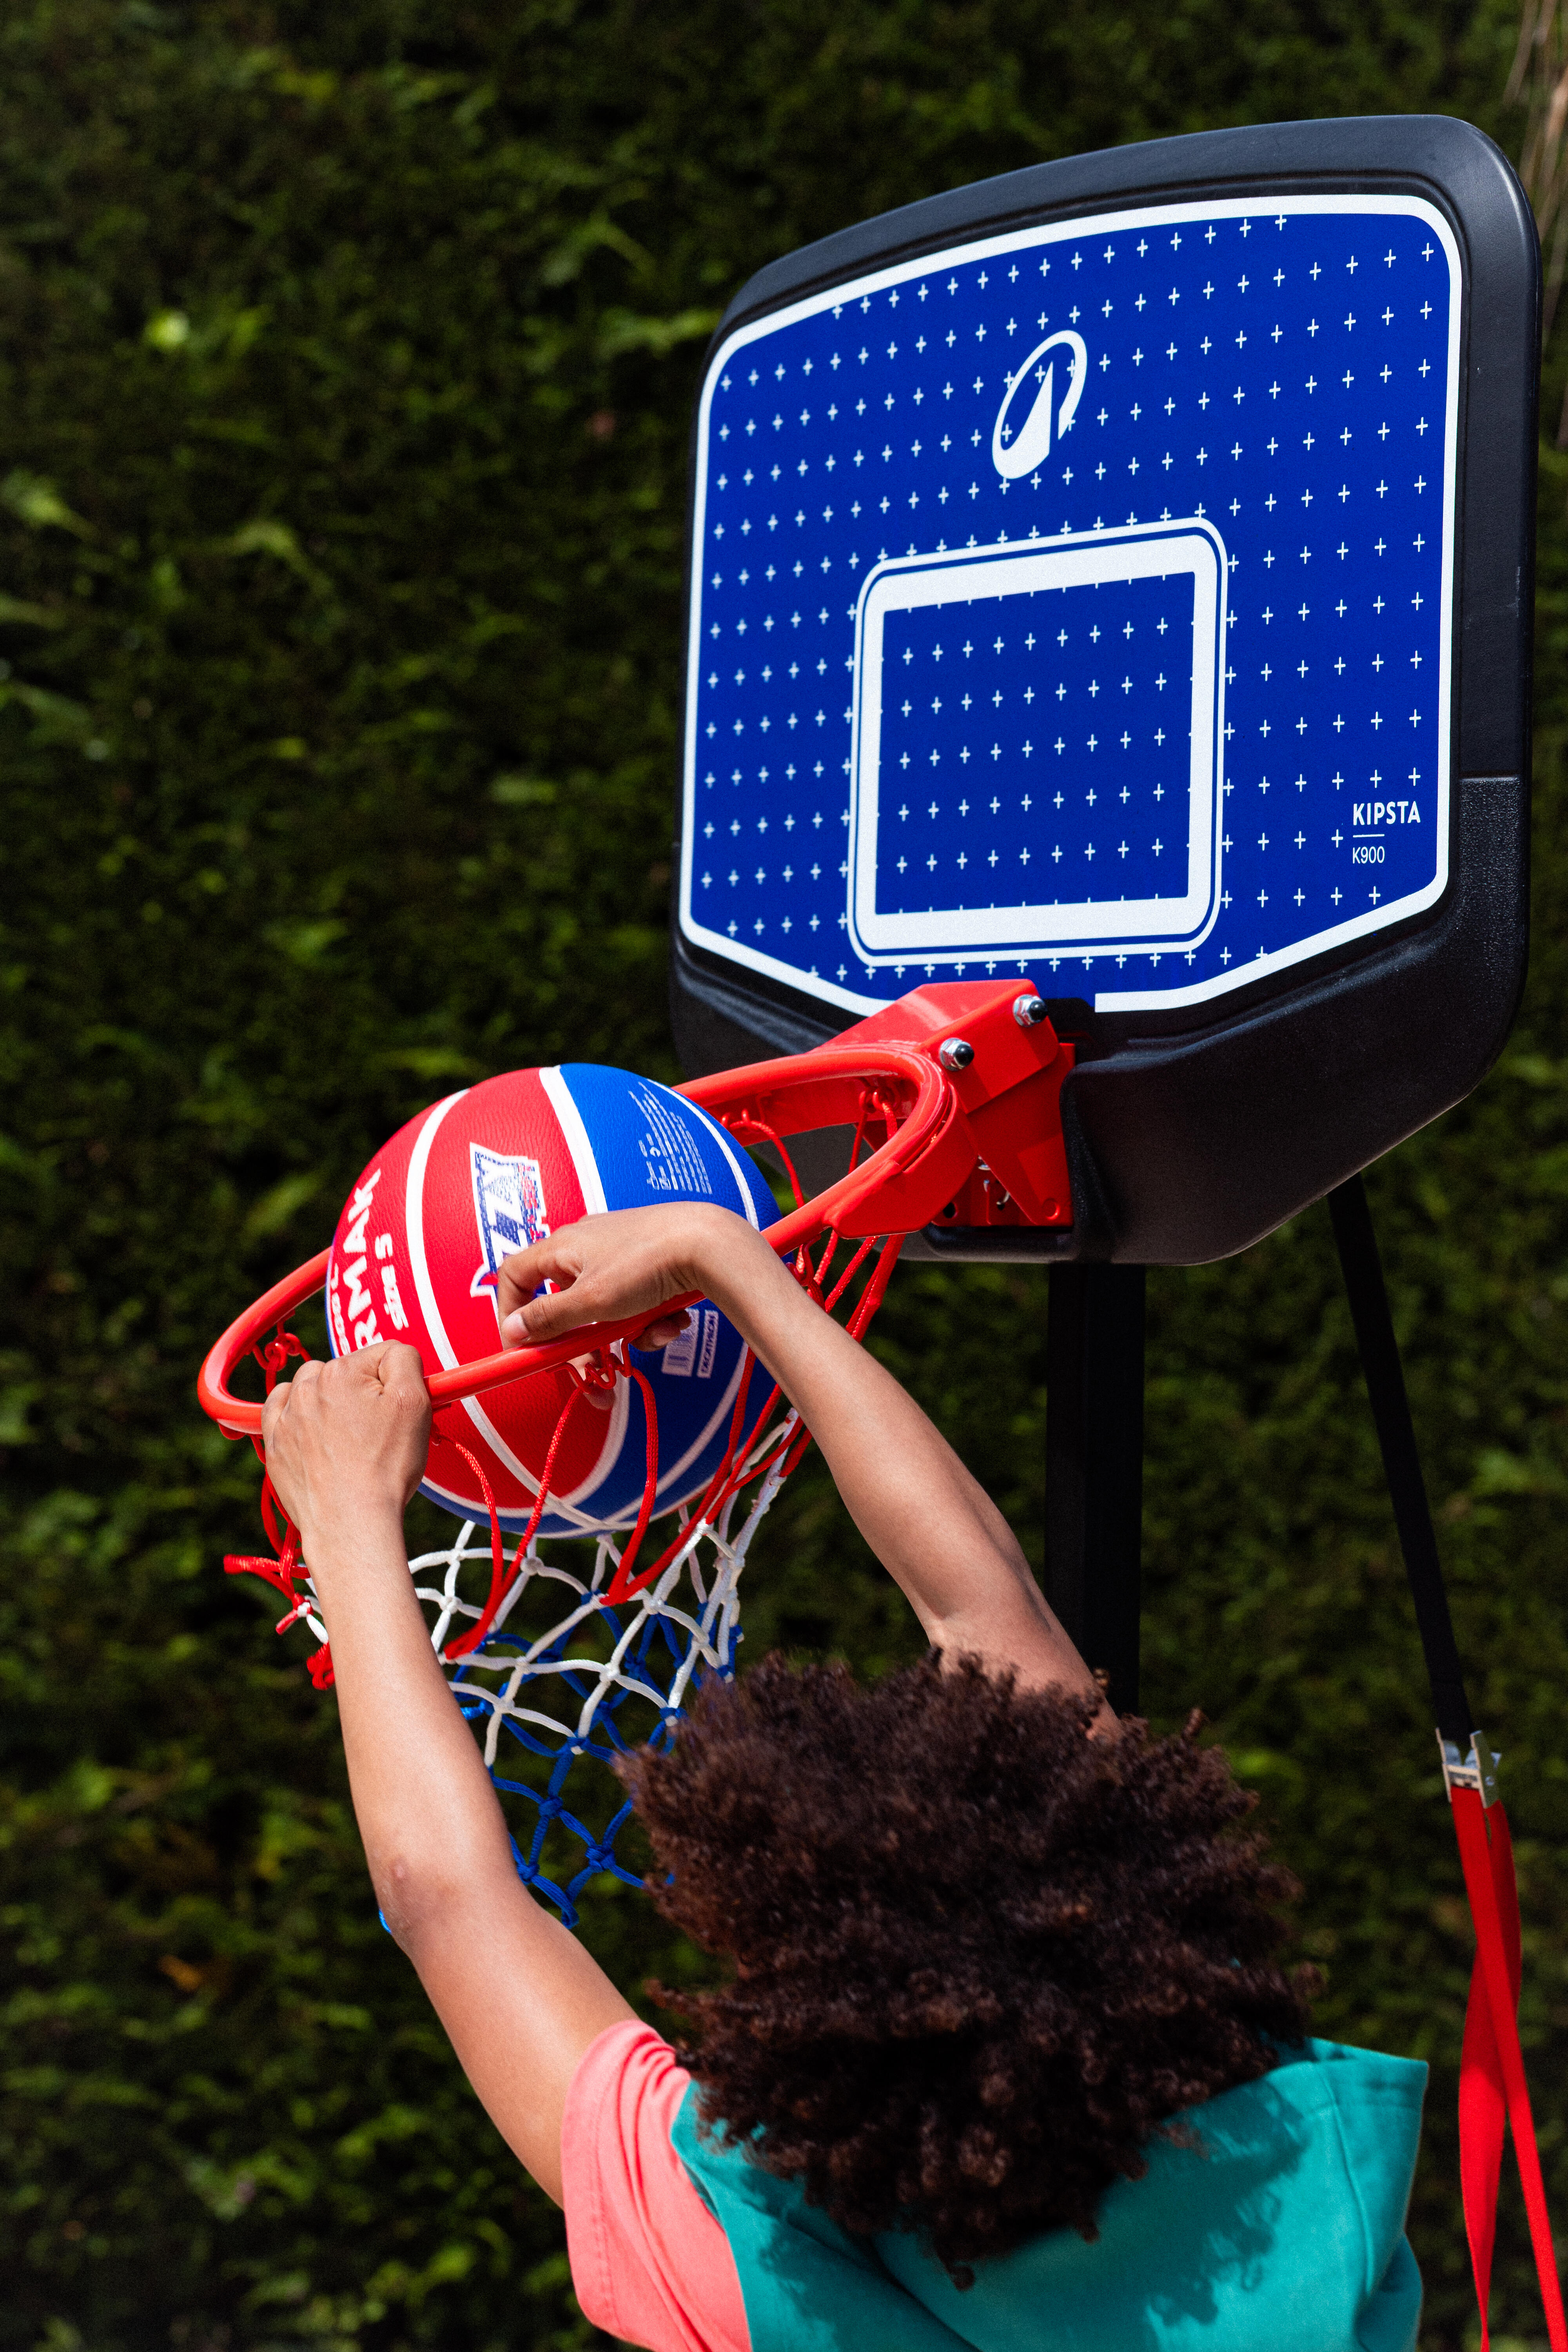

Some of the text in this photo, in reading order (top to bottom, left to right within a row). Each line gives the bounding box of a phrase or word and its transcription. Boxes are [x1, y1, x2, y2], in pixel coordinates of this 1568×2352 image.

[1353, 801, 1421, 825] KIPSTA
[1353, 846, 1385, 864] K900
[481, 1158, 528, 1269] ZZY
[343, 1168, 384, 1349] RMAK
[381, 1264, 409, 1330] size
